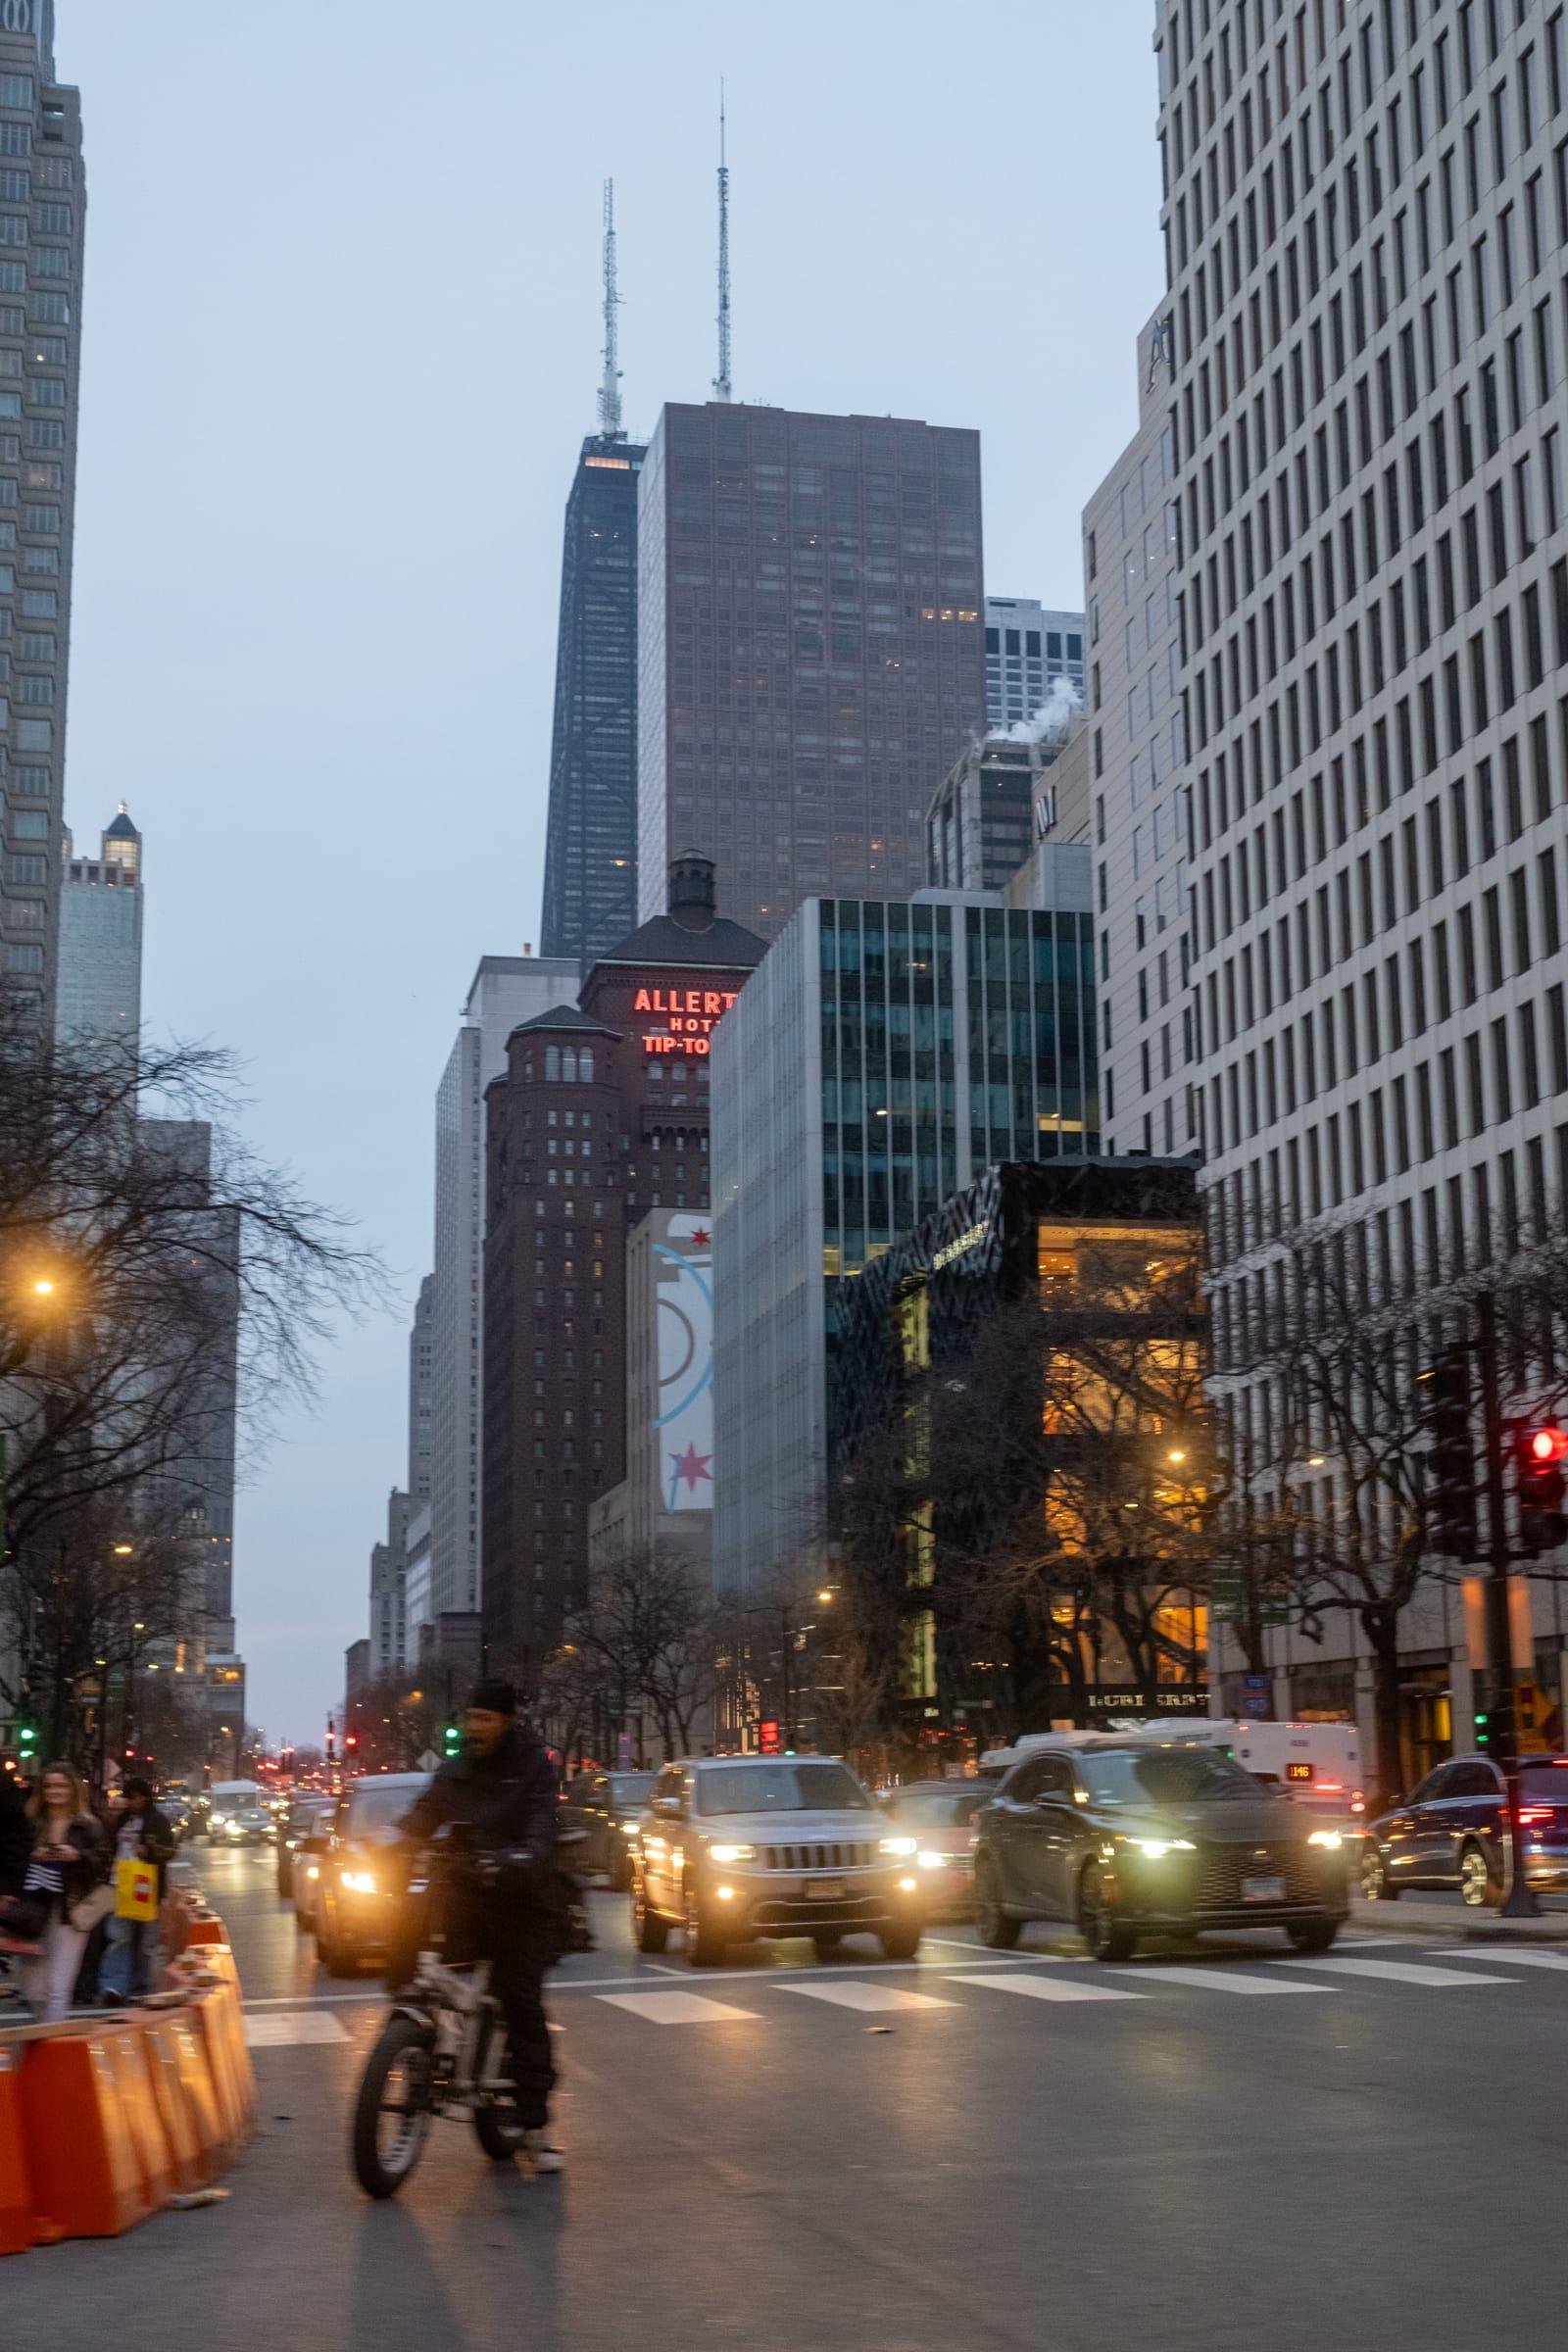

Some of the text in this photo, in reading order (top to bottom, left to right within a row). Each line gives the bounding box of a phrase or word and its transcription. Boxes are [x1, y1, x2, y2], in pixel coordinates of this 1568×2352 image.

[634, 989, 738, 1013] ALLERT
[669, 1017, 721, 1032] HOT
[643, 1035, 710, 1054] TIP-TO
